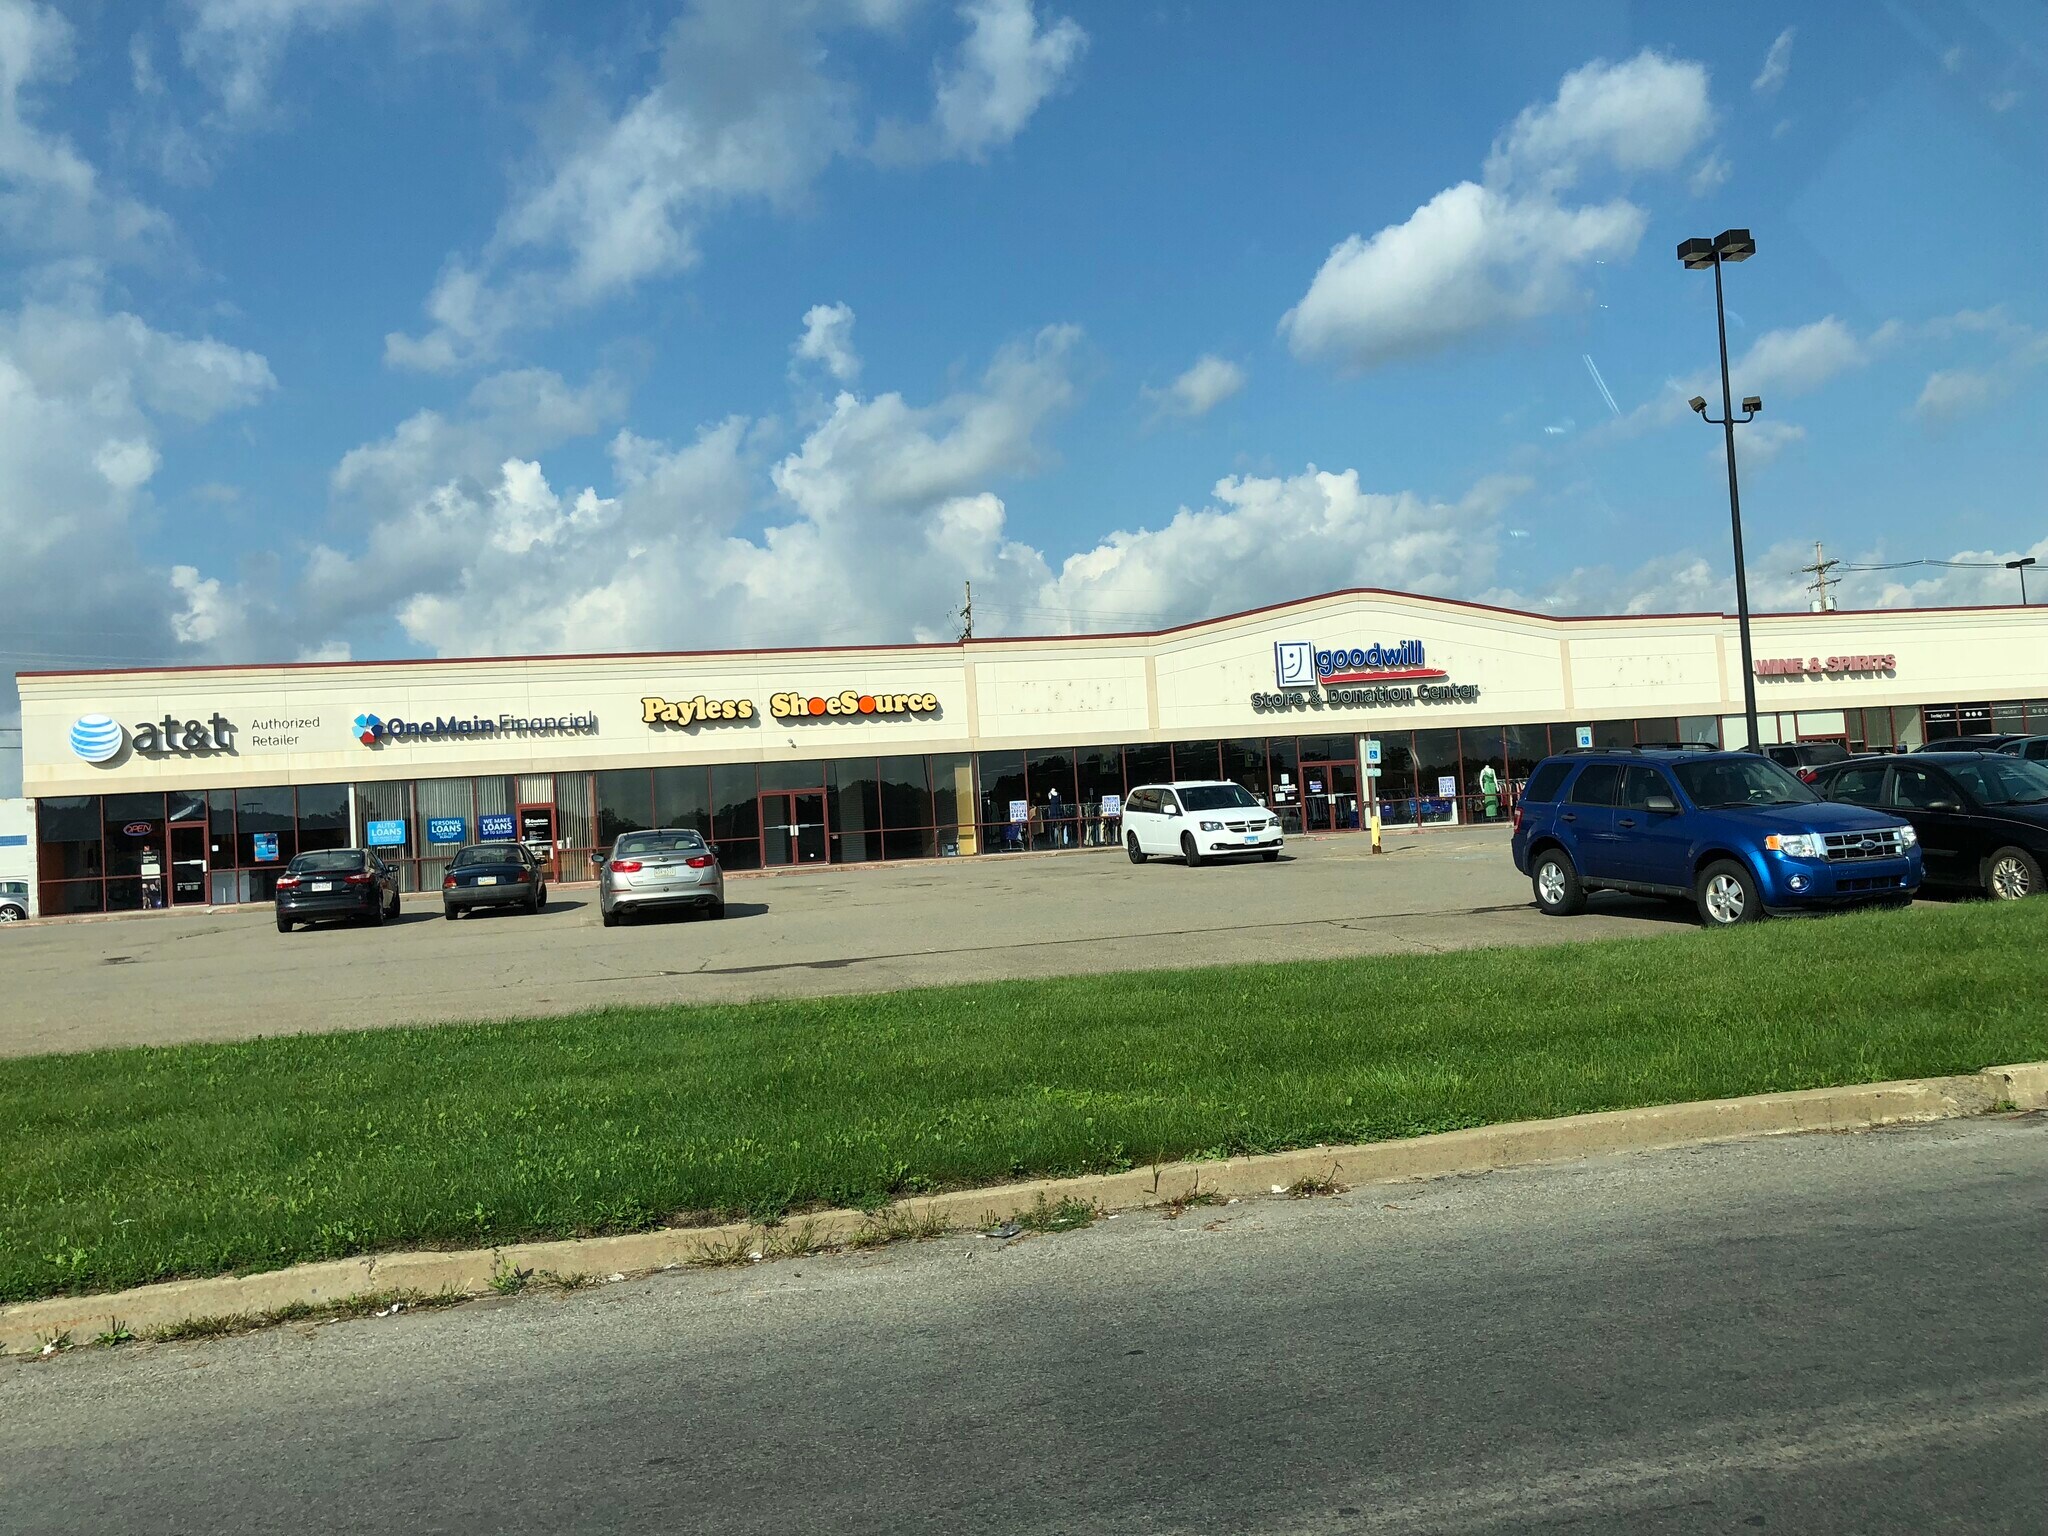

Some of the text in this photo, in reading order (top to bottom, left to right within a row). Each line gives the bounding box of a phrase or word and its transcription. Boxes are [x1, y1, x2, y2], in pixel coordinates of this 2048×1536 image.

[1315, 639, 1424, 677] goodwill
[1753, 654, 1897, 676] WINE & SPIRITS
[1250, 683, 1479, 708] Store & Donation Center
[641, 690, 937, 727] Payless ShoeSource
[132, 712, 230, 752] at&t
[251, 716, 320, 730] Authorized
[387, 711, 594, 737] OneMain Financial
[252, 734, 299, 746] Retailer
[128, 824, 152, 833] OPEN
[371, 828, 402, 836] LOANS
[431, 824, 462, 833] LOANS
[482, 822, 513, 831] LOANS
